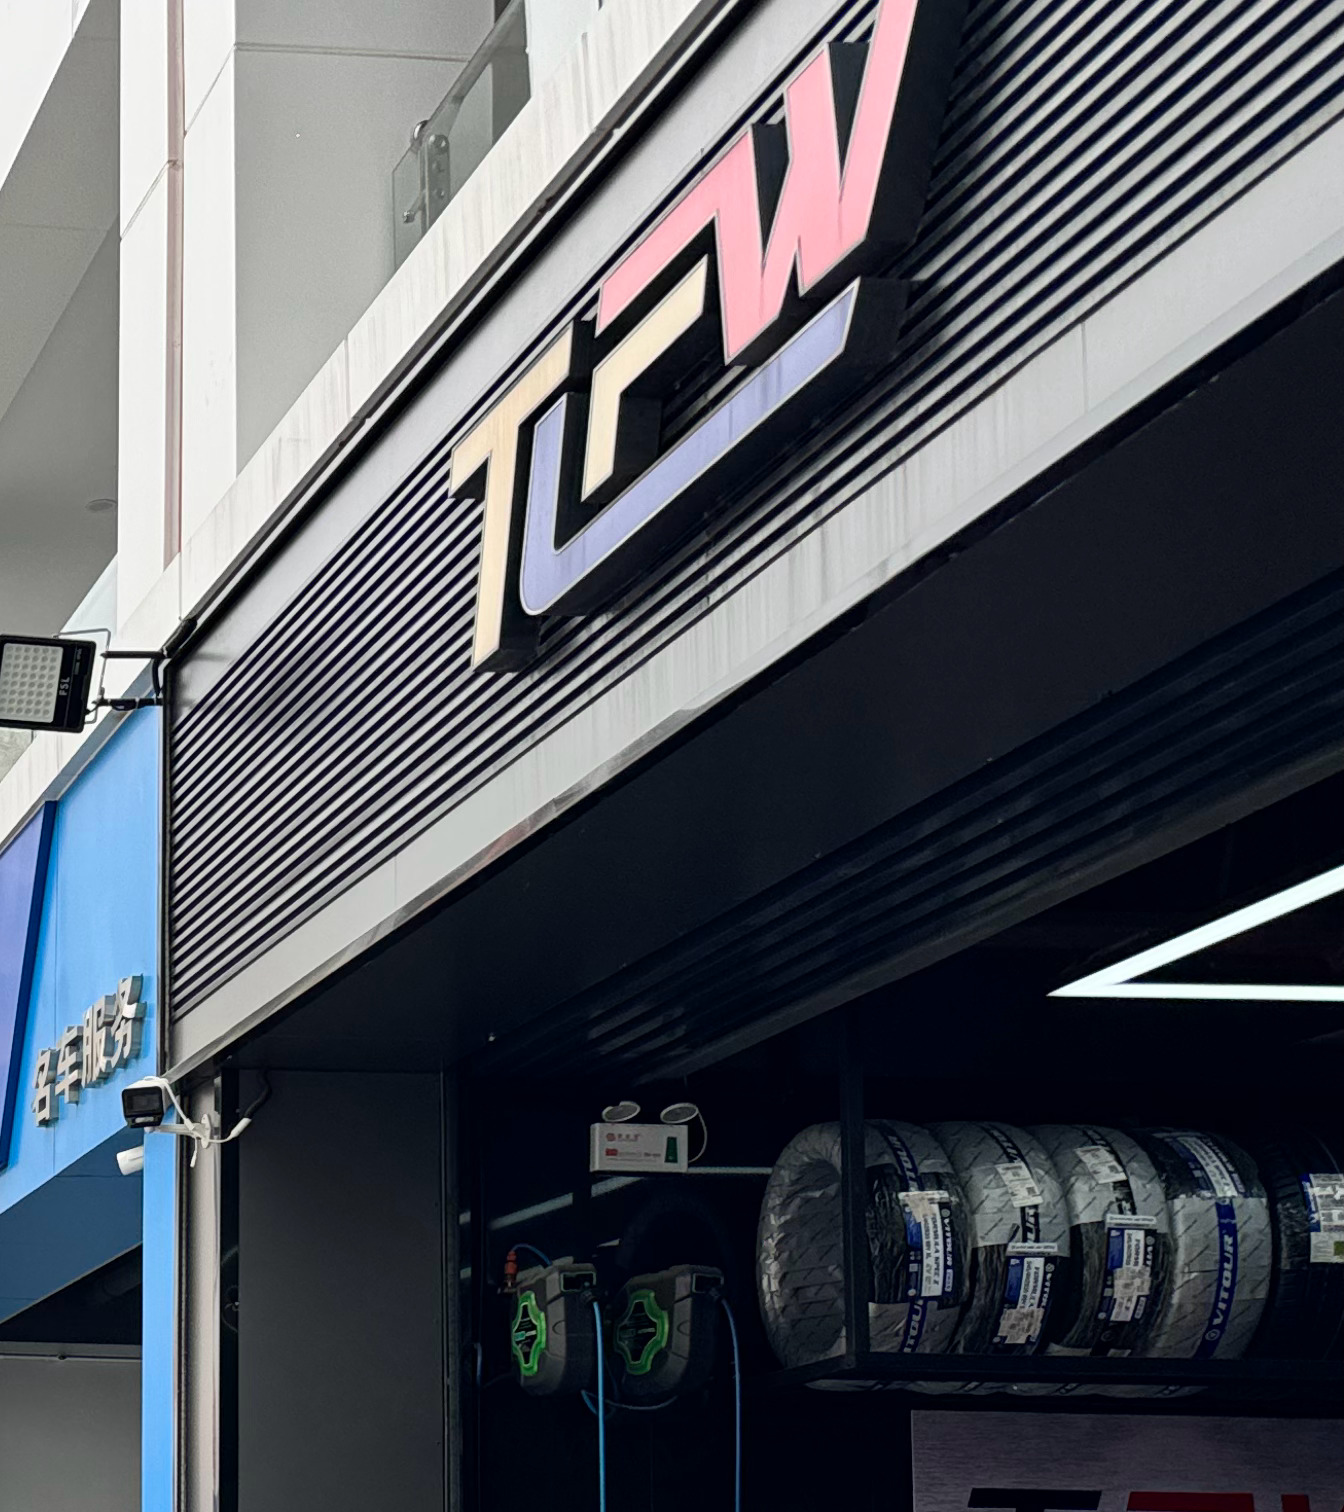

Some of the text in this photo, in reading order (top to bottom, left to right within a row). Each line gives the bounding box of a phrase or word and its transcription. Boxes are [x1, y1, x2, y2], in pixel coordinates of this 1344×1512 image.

[29, 974, 146, 1128] 名车服务
[1212, 1234, 1234, 1325] VITOUR
